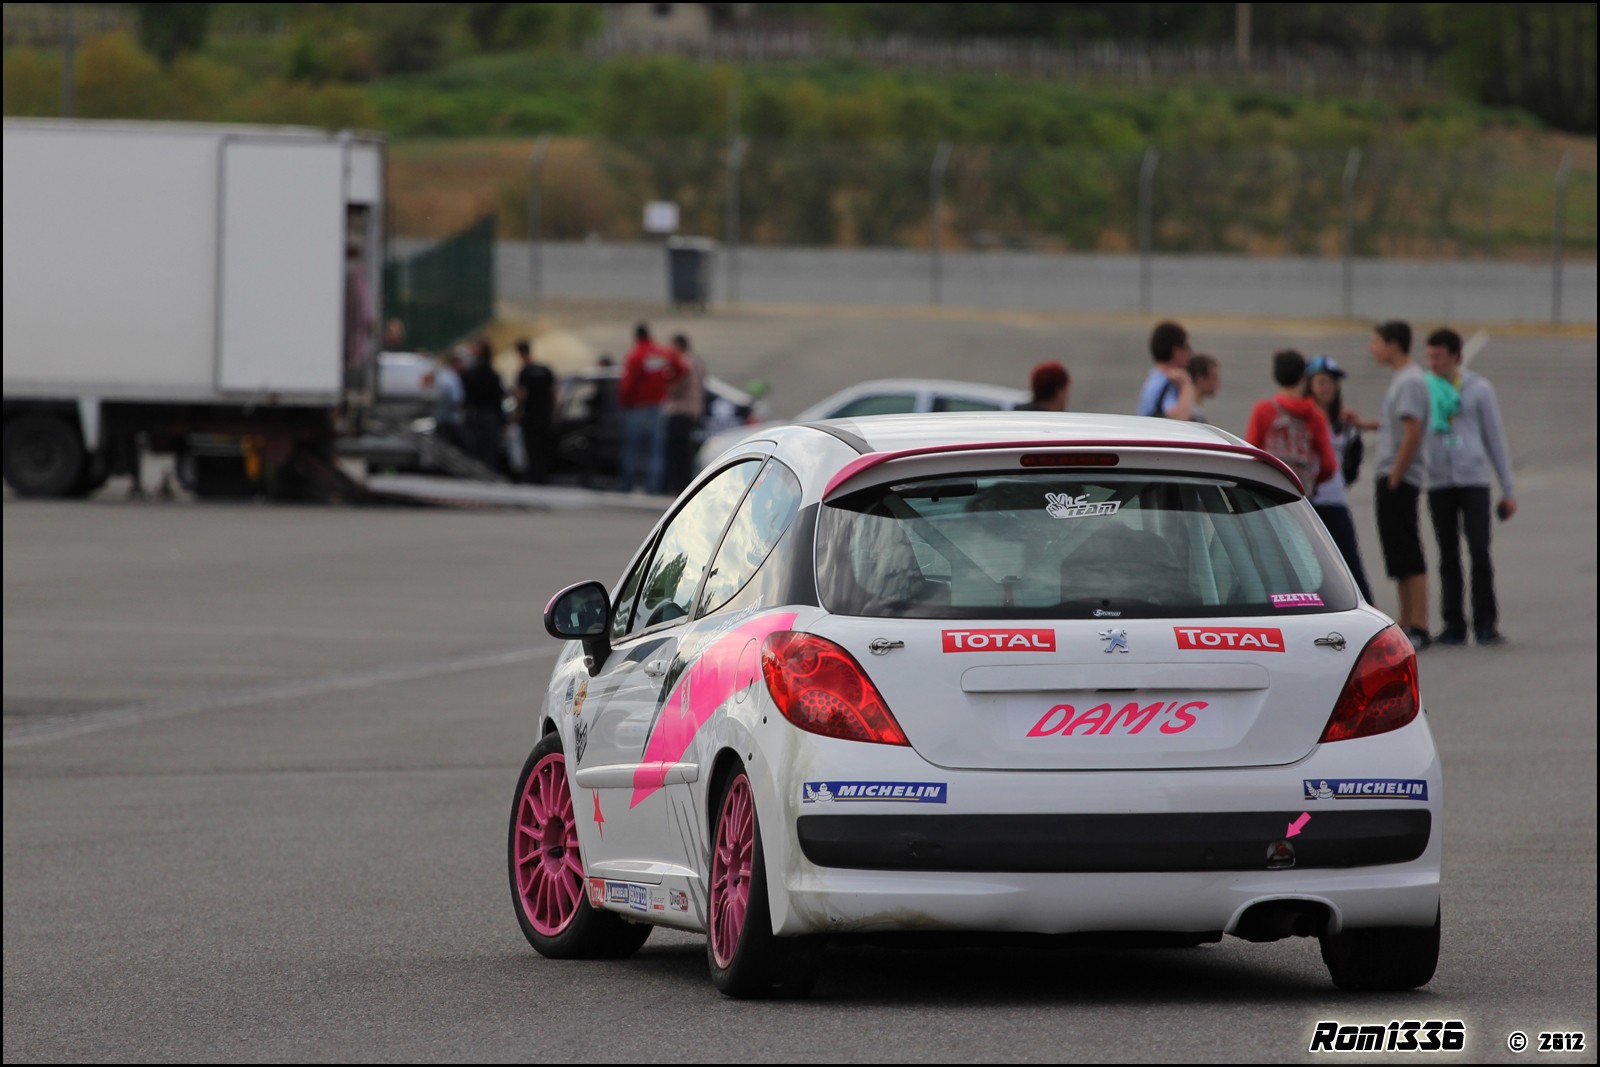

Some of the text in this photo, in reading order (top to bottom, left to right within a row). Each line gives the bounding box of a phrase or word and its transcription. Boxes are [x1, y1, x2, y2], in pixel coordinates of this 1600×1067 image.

[1068, 503, 1117, 516] TEAM
[1271, 593, 1321, 603] ZEZETTE
[1026, 701, 1209, 738] DAM'S
[837, 785, 941, 798] MICHELIN
[1337, 781, 1424, 796] MICHELIN
